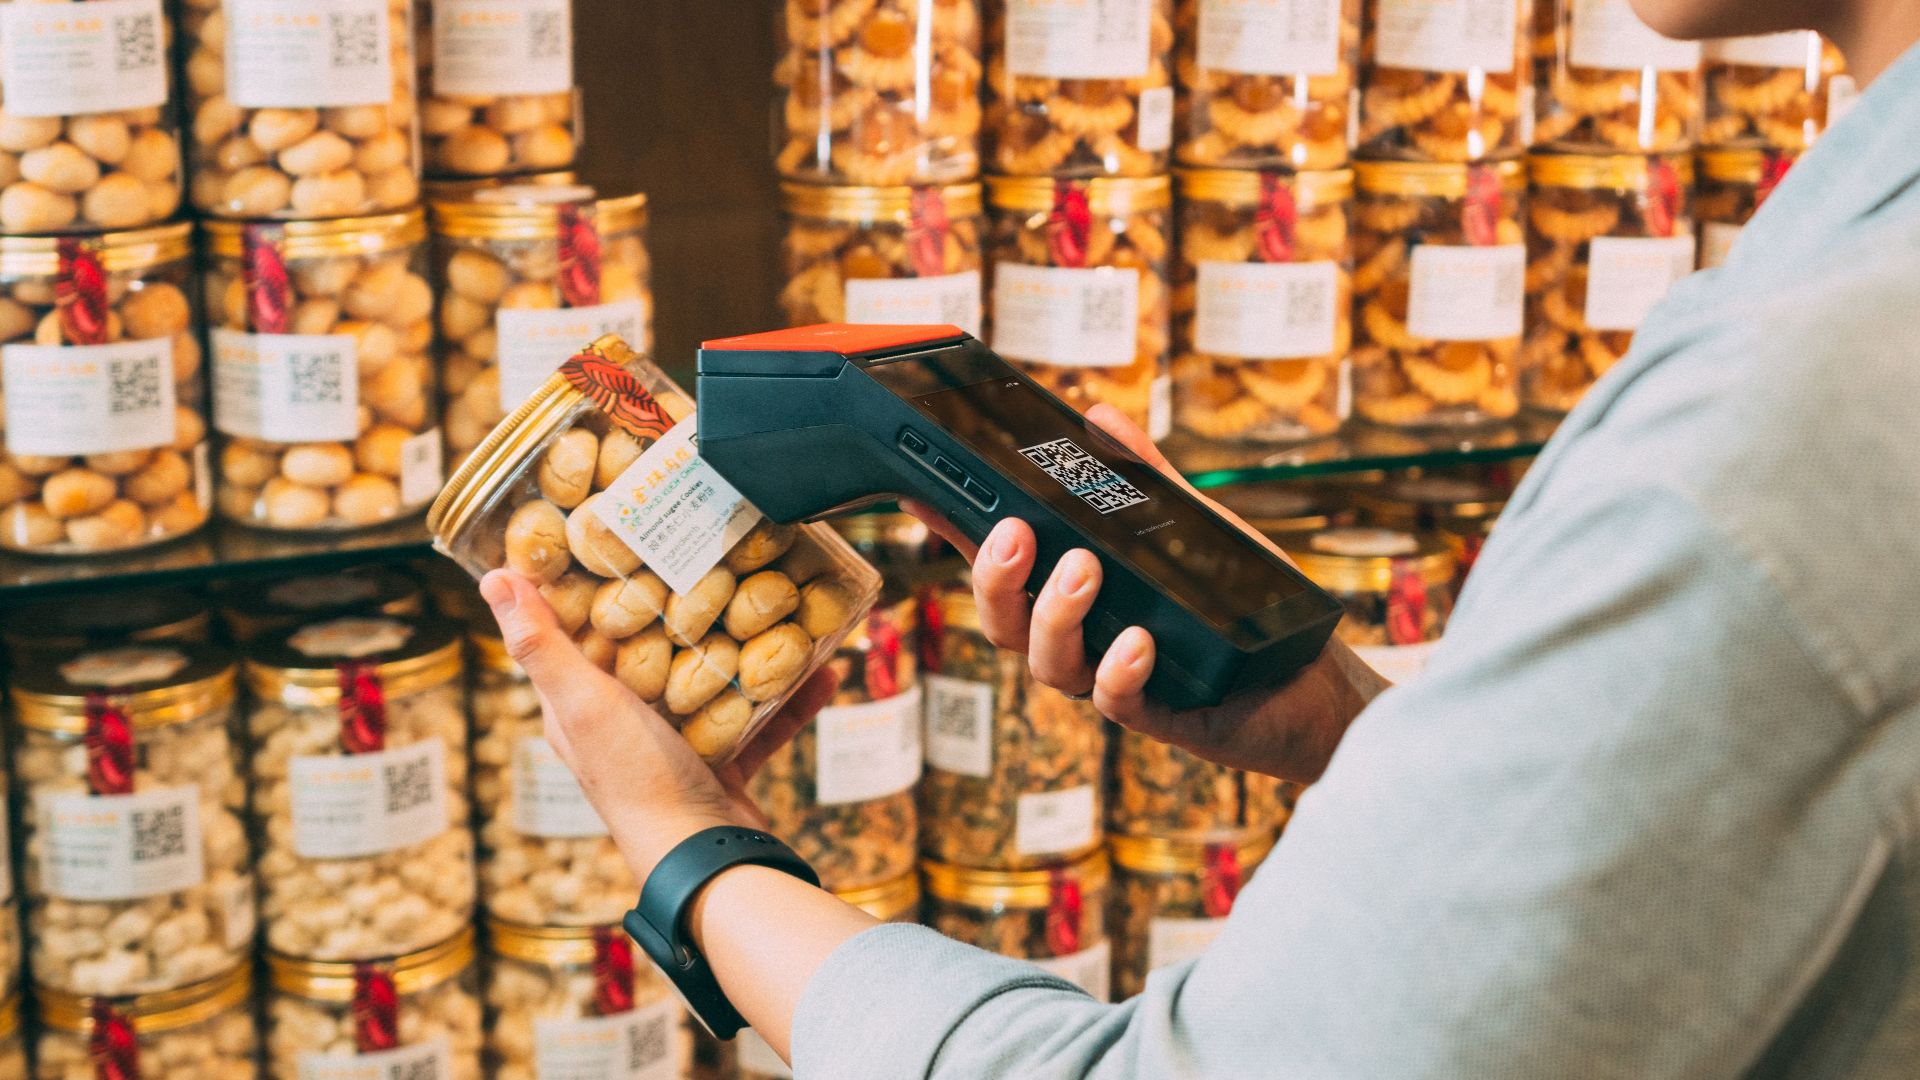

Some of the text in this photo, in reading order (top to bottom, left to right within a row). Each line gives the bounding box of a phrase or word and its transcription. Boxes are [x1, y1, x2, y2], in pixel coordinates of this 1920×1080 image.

[639, 478, 704, 543] Almond sugee Cookies
